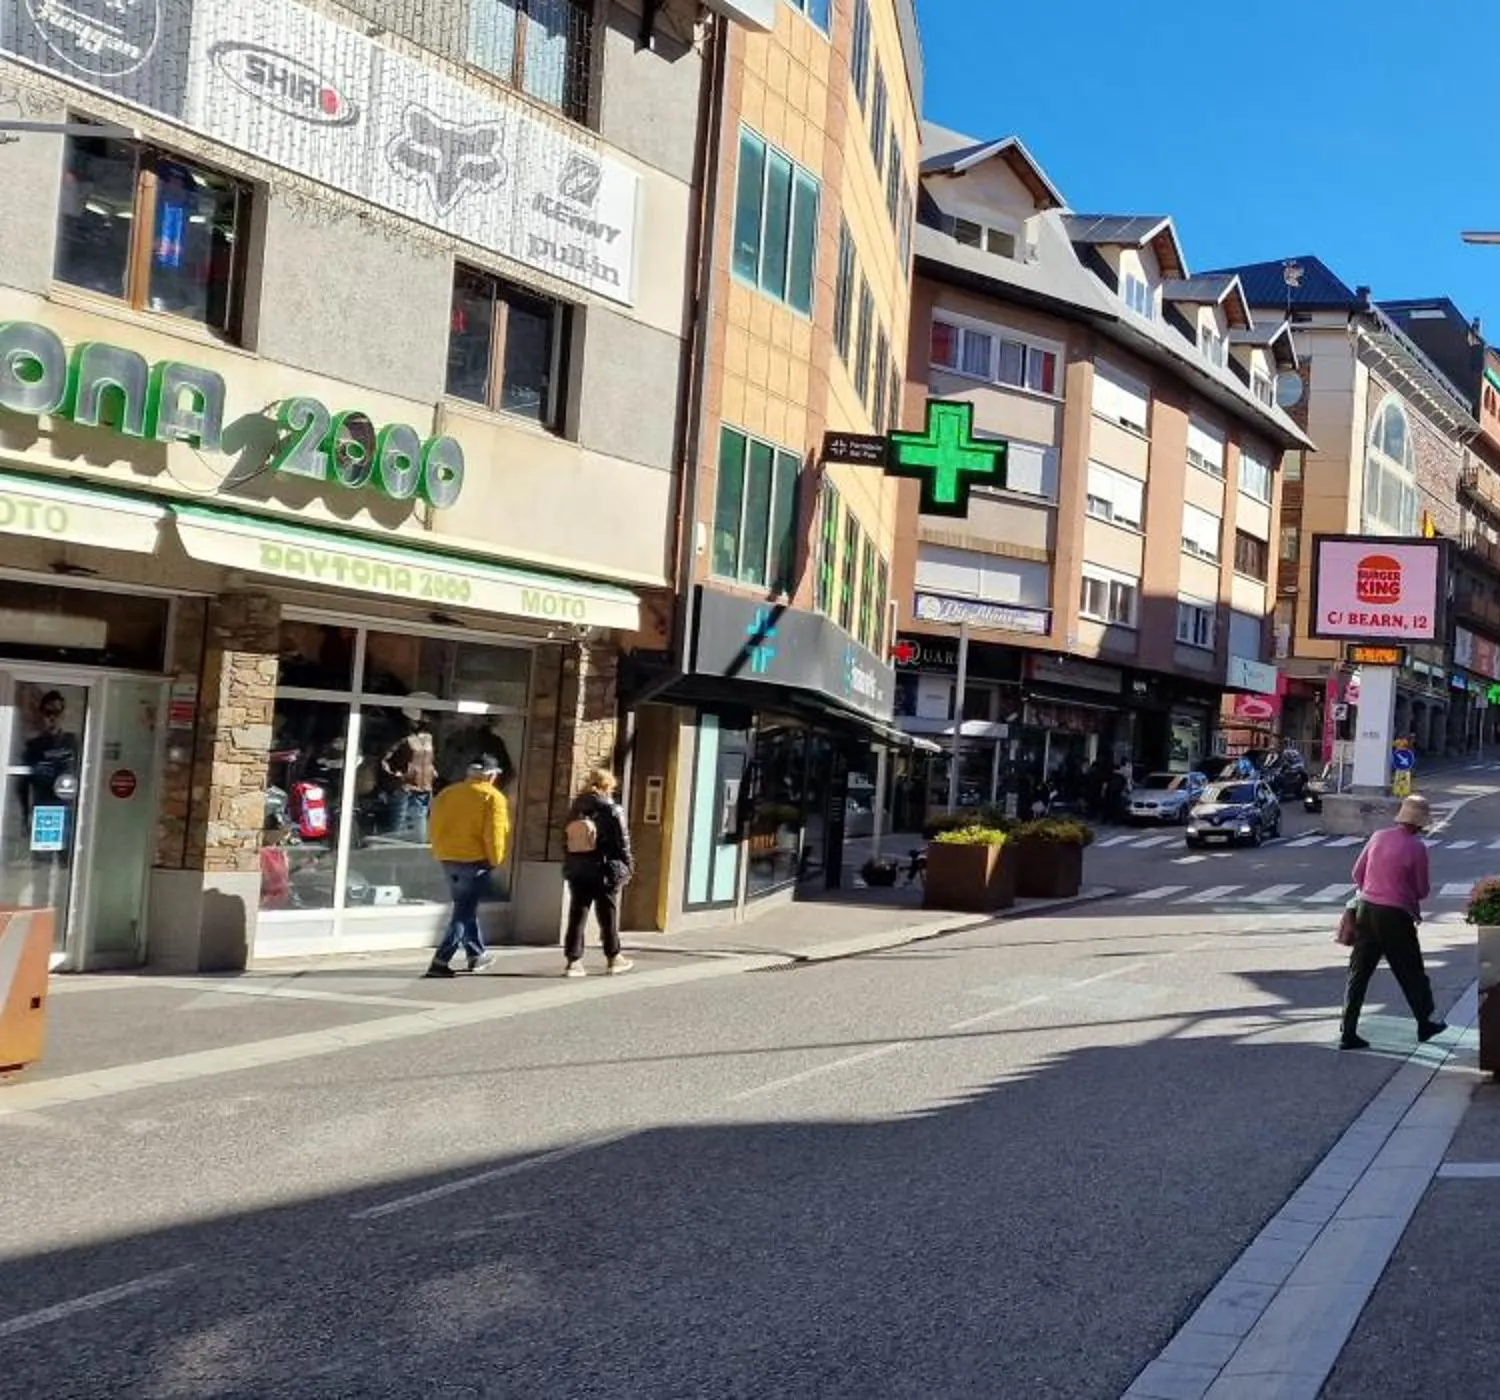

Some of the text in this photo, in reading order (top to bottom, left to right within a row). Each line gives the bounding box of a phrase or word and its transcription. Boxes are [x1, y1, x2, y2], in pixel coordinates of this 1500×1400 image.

[531, 192, 621, 244] KENNY
[272, 397, 465, 508] 2000
[1357, 570, 1400, 581] BURGER
[1357, 582, 1400, 595] KING
[521, 589, 587, 619] MOTO
[1348, 612, 1409, 631] BEARN,
[1413, 615, 1428, 629] 12
[898, 639, 962, 667] QUAR
